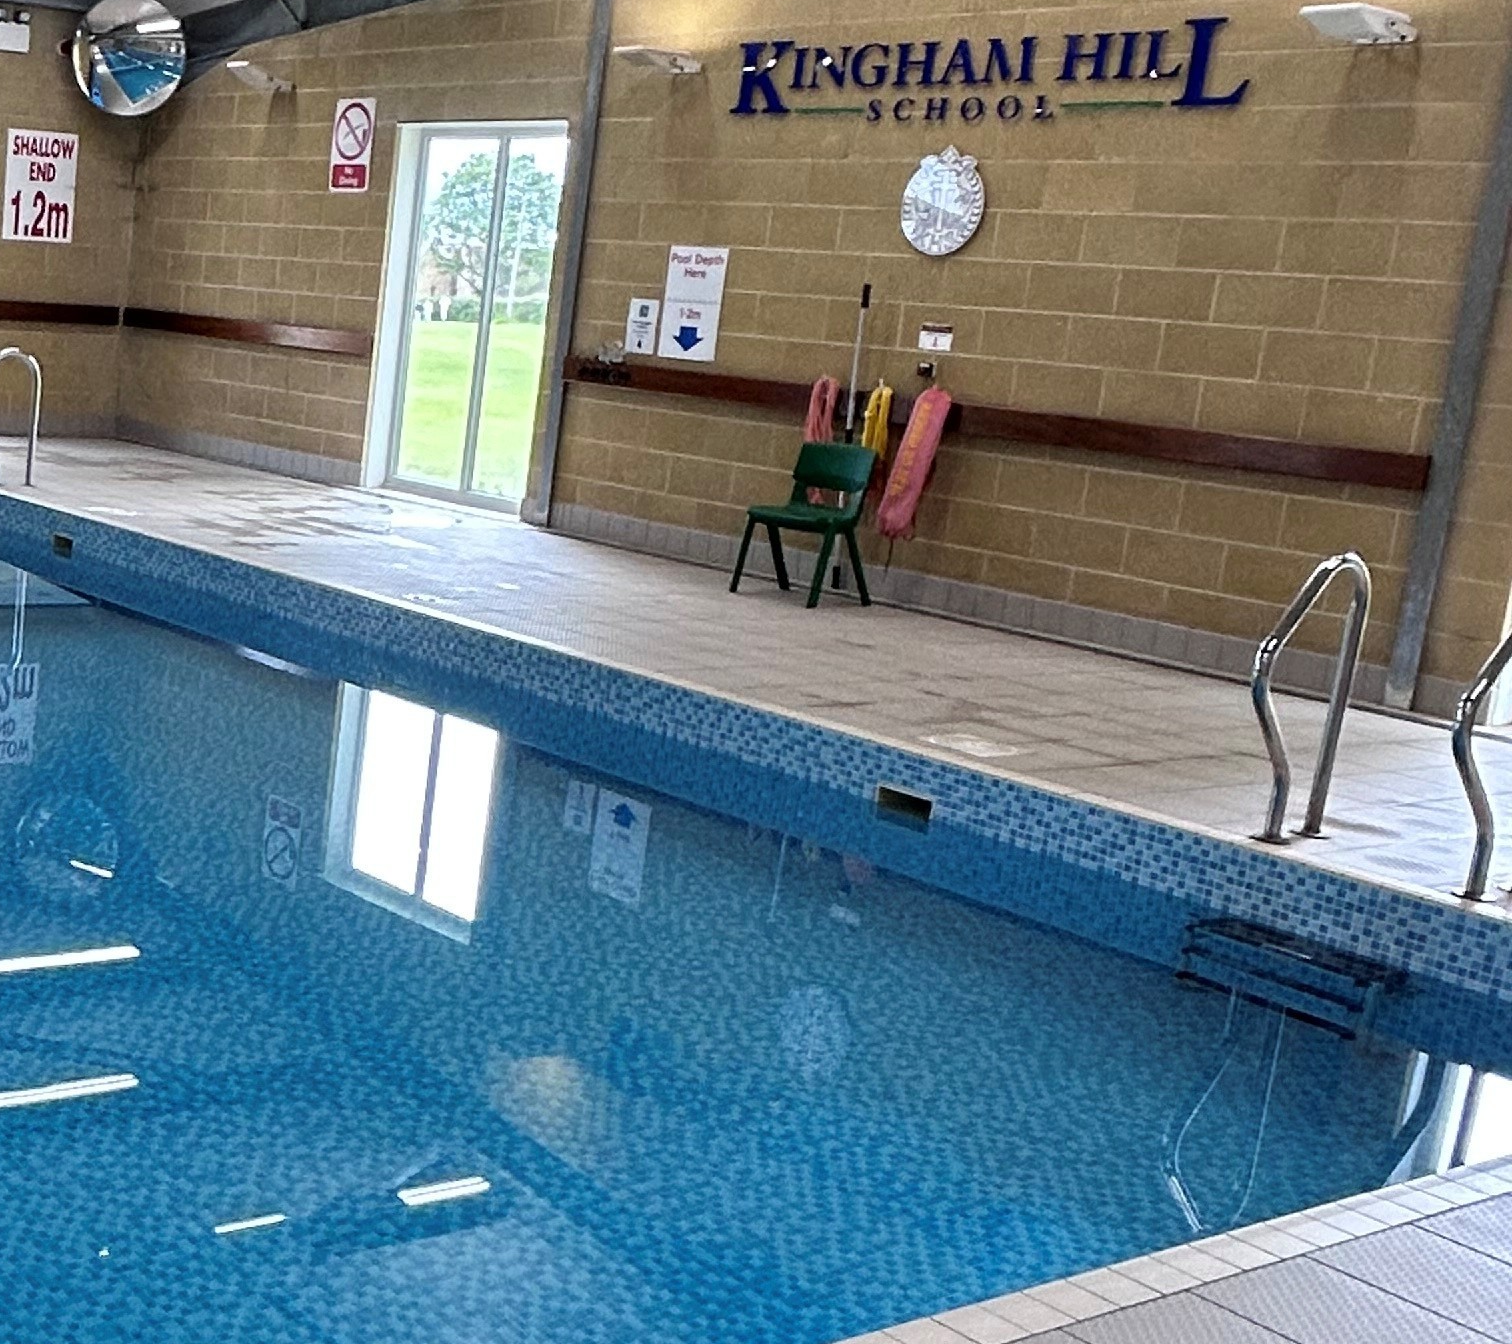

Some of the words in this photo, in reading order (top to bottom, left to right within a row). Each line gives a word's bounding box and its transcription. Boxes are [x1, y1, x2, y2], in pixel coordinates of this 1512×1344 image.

[729, 37, 1038, 114] KINGHAM
[1054, 17, 1251, 106] HILL
[866, 95, 1054, 122] SCHOOL
[12, 135, 75, 159] SHALLOW
[29, 161, 56, 182] END
[11, 190, 69, 238] 1.2m
